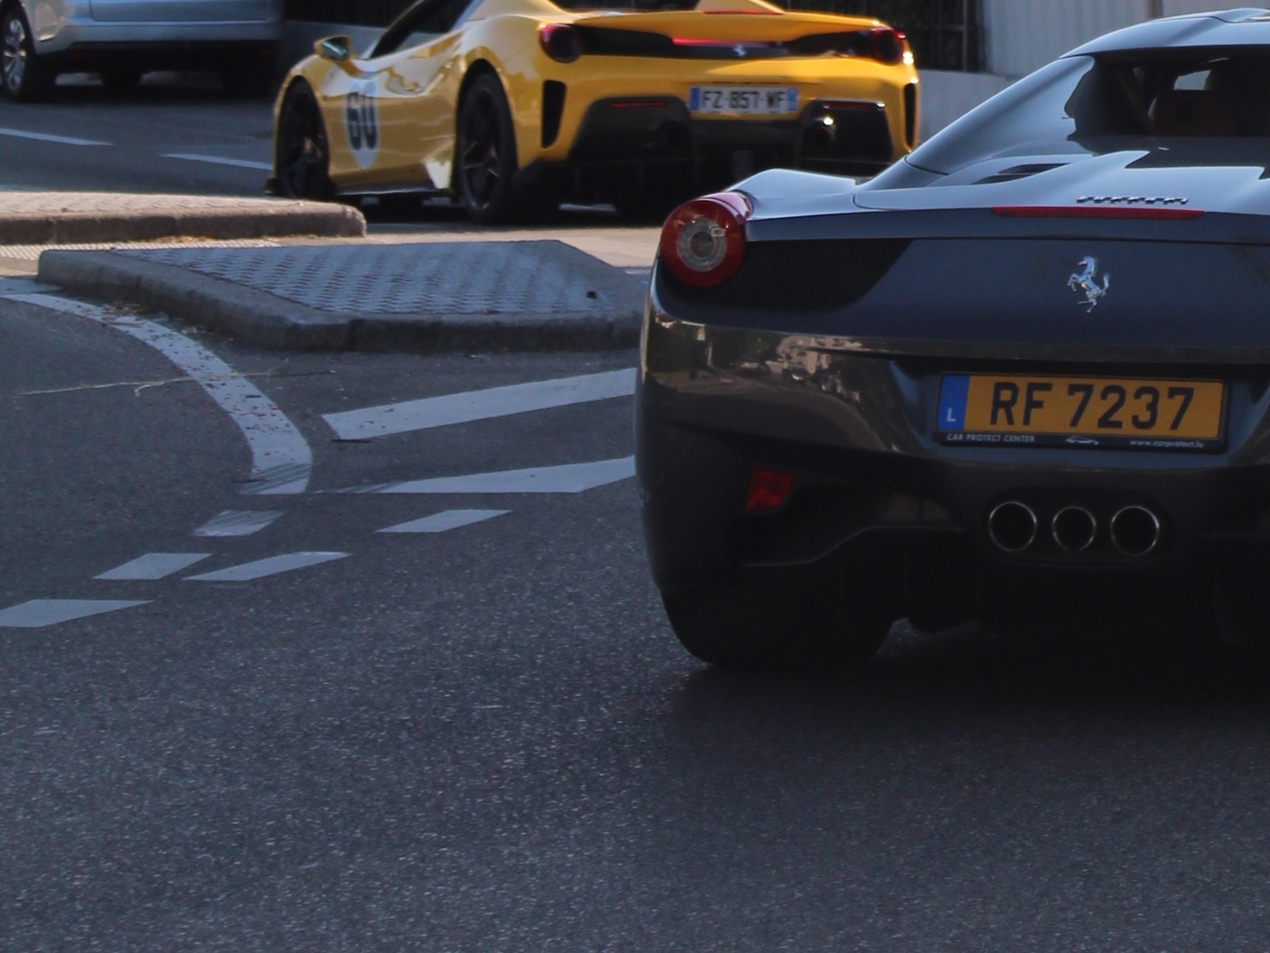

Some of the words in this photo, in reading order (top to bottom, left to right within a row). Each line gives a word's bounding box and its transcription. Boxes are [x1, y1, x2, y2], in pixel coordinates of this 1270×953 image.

[346, 92, 378, 151] 60
[946, 407, 956, 422] L
[989, 381, 1054, 427] RF
[1066, 383, 1195, 431] 7237
[946, 433, 964, 441] CAR
[965, 434, 1001, 442] PROTECT
[1003, 435, 1036, 443] CENTER
